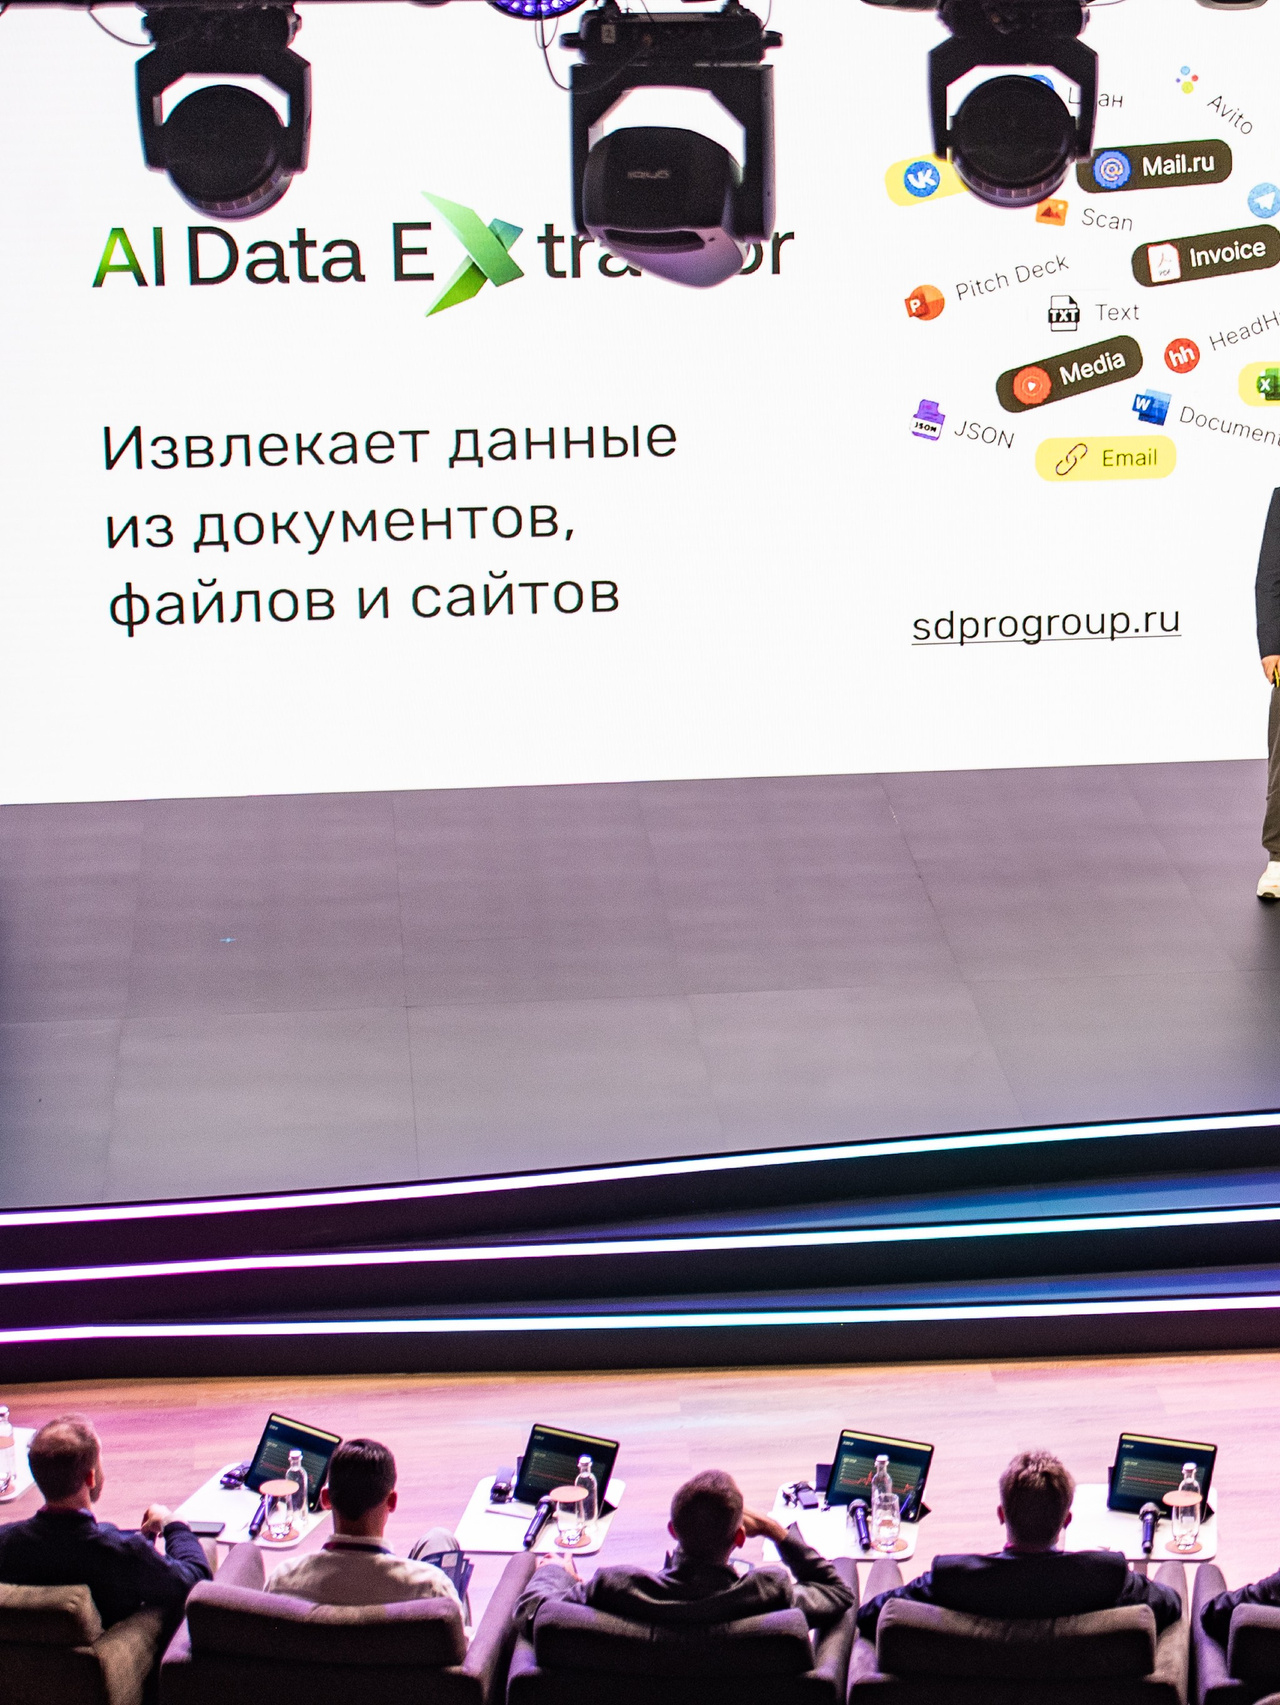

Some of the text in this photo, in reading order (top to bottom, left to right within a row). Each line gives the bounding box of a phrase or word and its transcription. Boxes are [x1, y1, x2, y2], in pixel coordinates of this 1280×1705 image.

[1206, 95, 1253, 135] Avito
[907, 168, 937, 189] VK
[1142, 153, 1215, 177] Mail.ru
[1081, 207, 1133, 232] Scan
[91, 226, 165, 288] AI
[187, 225, 365, 285] Data
[1189, 240, 1267, 268] Invoice
[955, 254, 1070, 301] Pitch Deck
[1050, 308, 1079, 323] TXT
[1095, 303, 1140, 322] Text
[1060, 351, 1127, 386] Media
[1168, 344, 1196, 367] hh
[914, 421, 938, 433] JSON
[953, 420, 1015, 450] JSON
[103, 423, 677, 471] Извлекает данные
[1103, 449, 1157, 467] Email
[106, 504, 574, 556] из документов,
[109, 569, 619, 638] файлов и сайтов
[912, 611, 1182, 643] sdprogroup.ru
